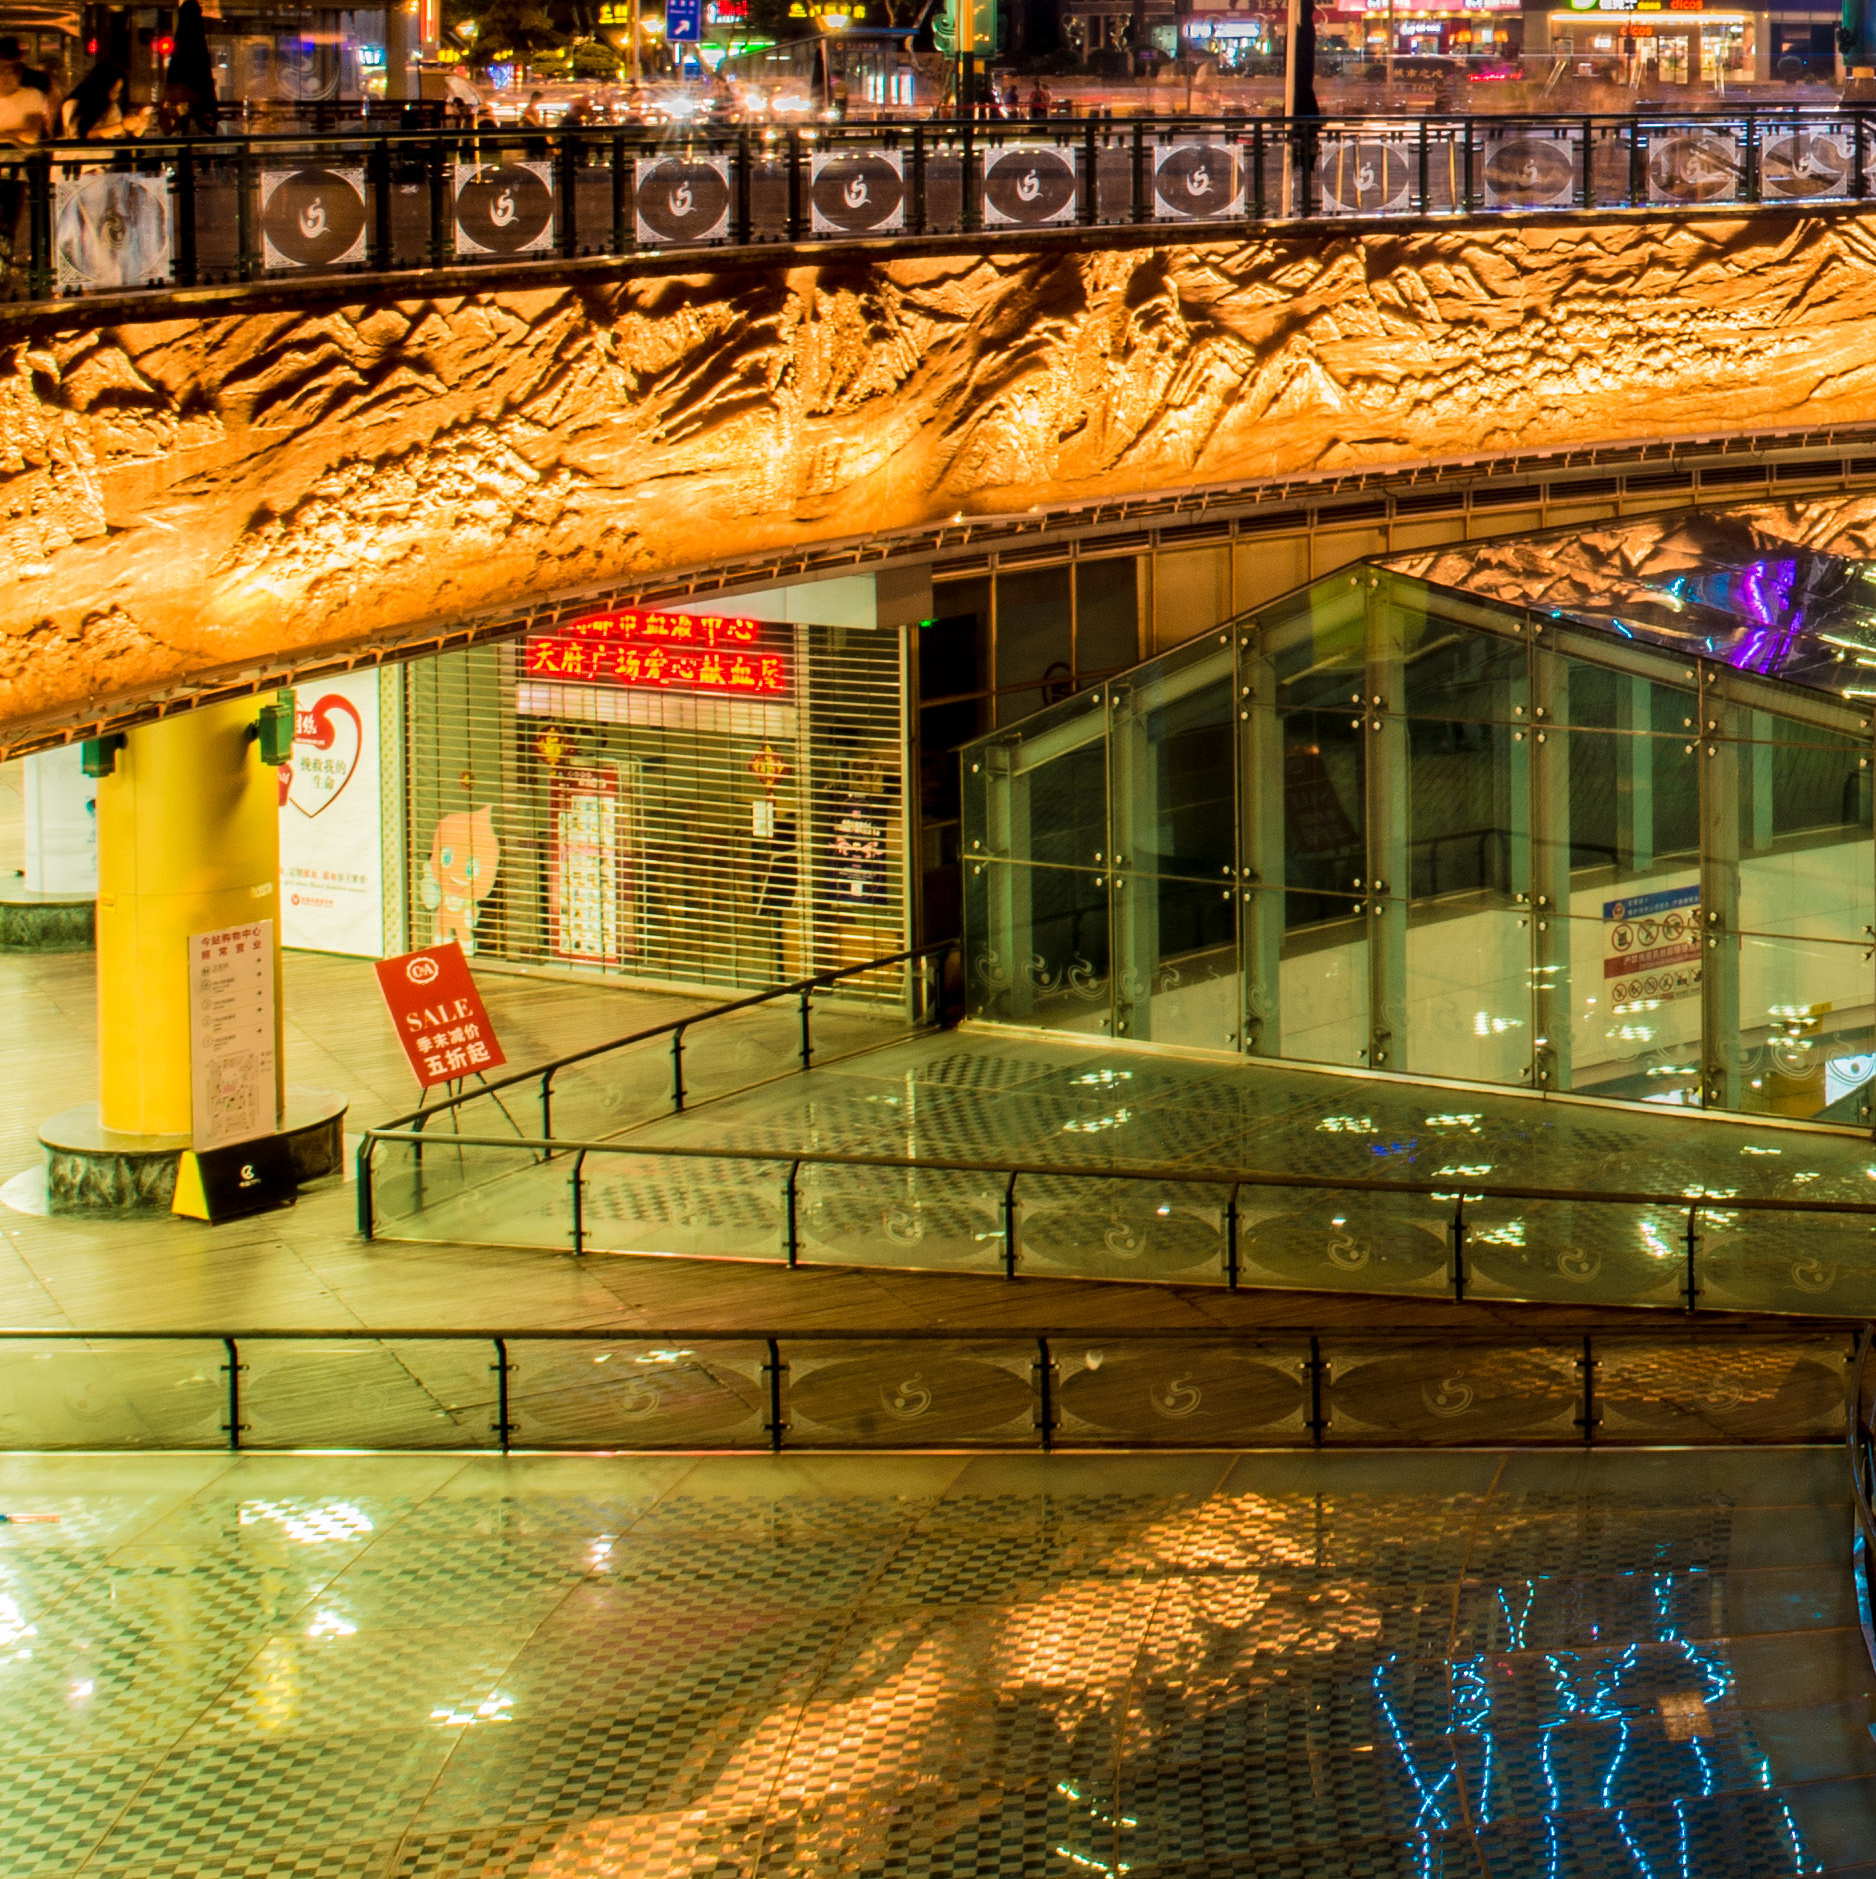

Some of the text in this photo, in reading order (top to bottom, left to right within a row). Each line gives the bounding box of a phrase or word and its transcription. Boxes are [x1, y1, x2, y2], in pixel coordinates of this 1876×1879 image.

[530, 640, 783, 691] 天府广场爱心献血屋
[300, 756, 347, 775] 挽救我的
[313, 774, 335, 791] 生命
[200, 926, 262, 947] 今站购物中心
[406, 997, 474, 1033] SALE
[416, 1023, 481, 1054] 季末减价
[424, 1041, 491, 1077] 五折起
